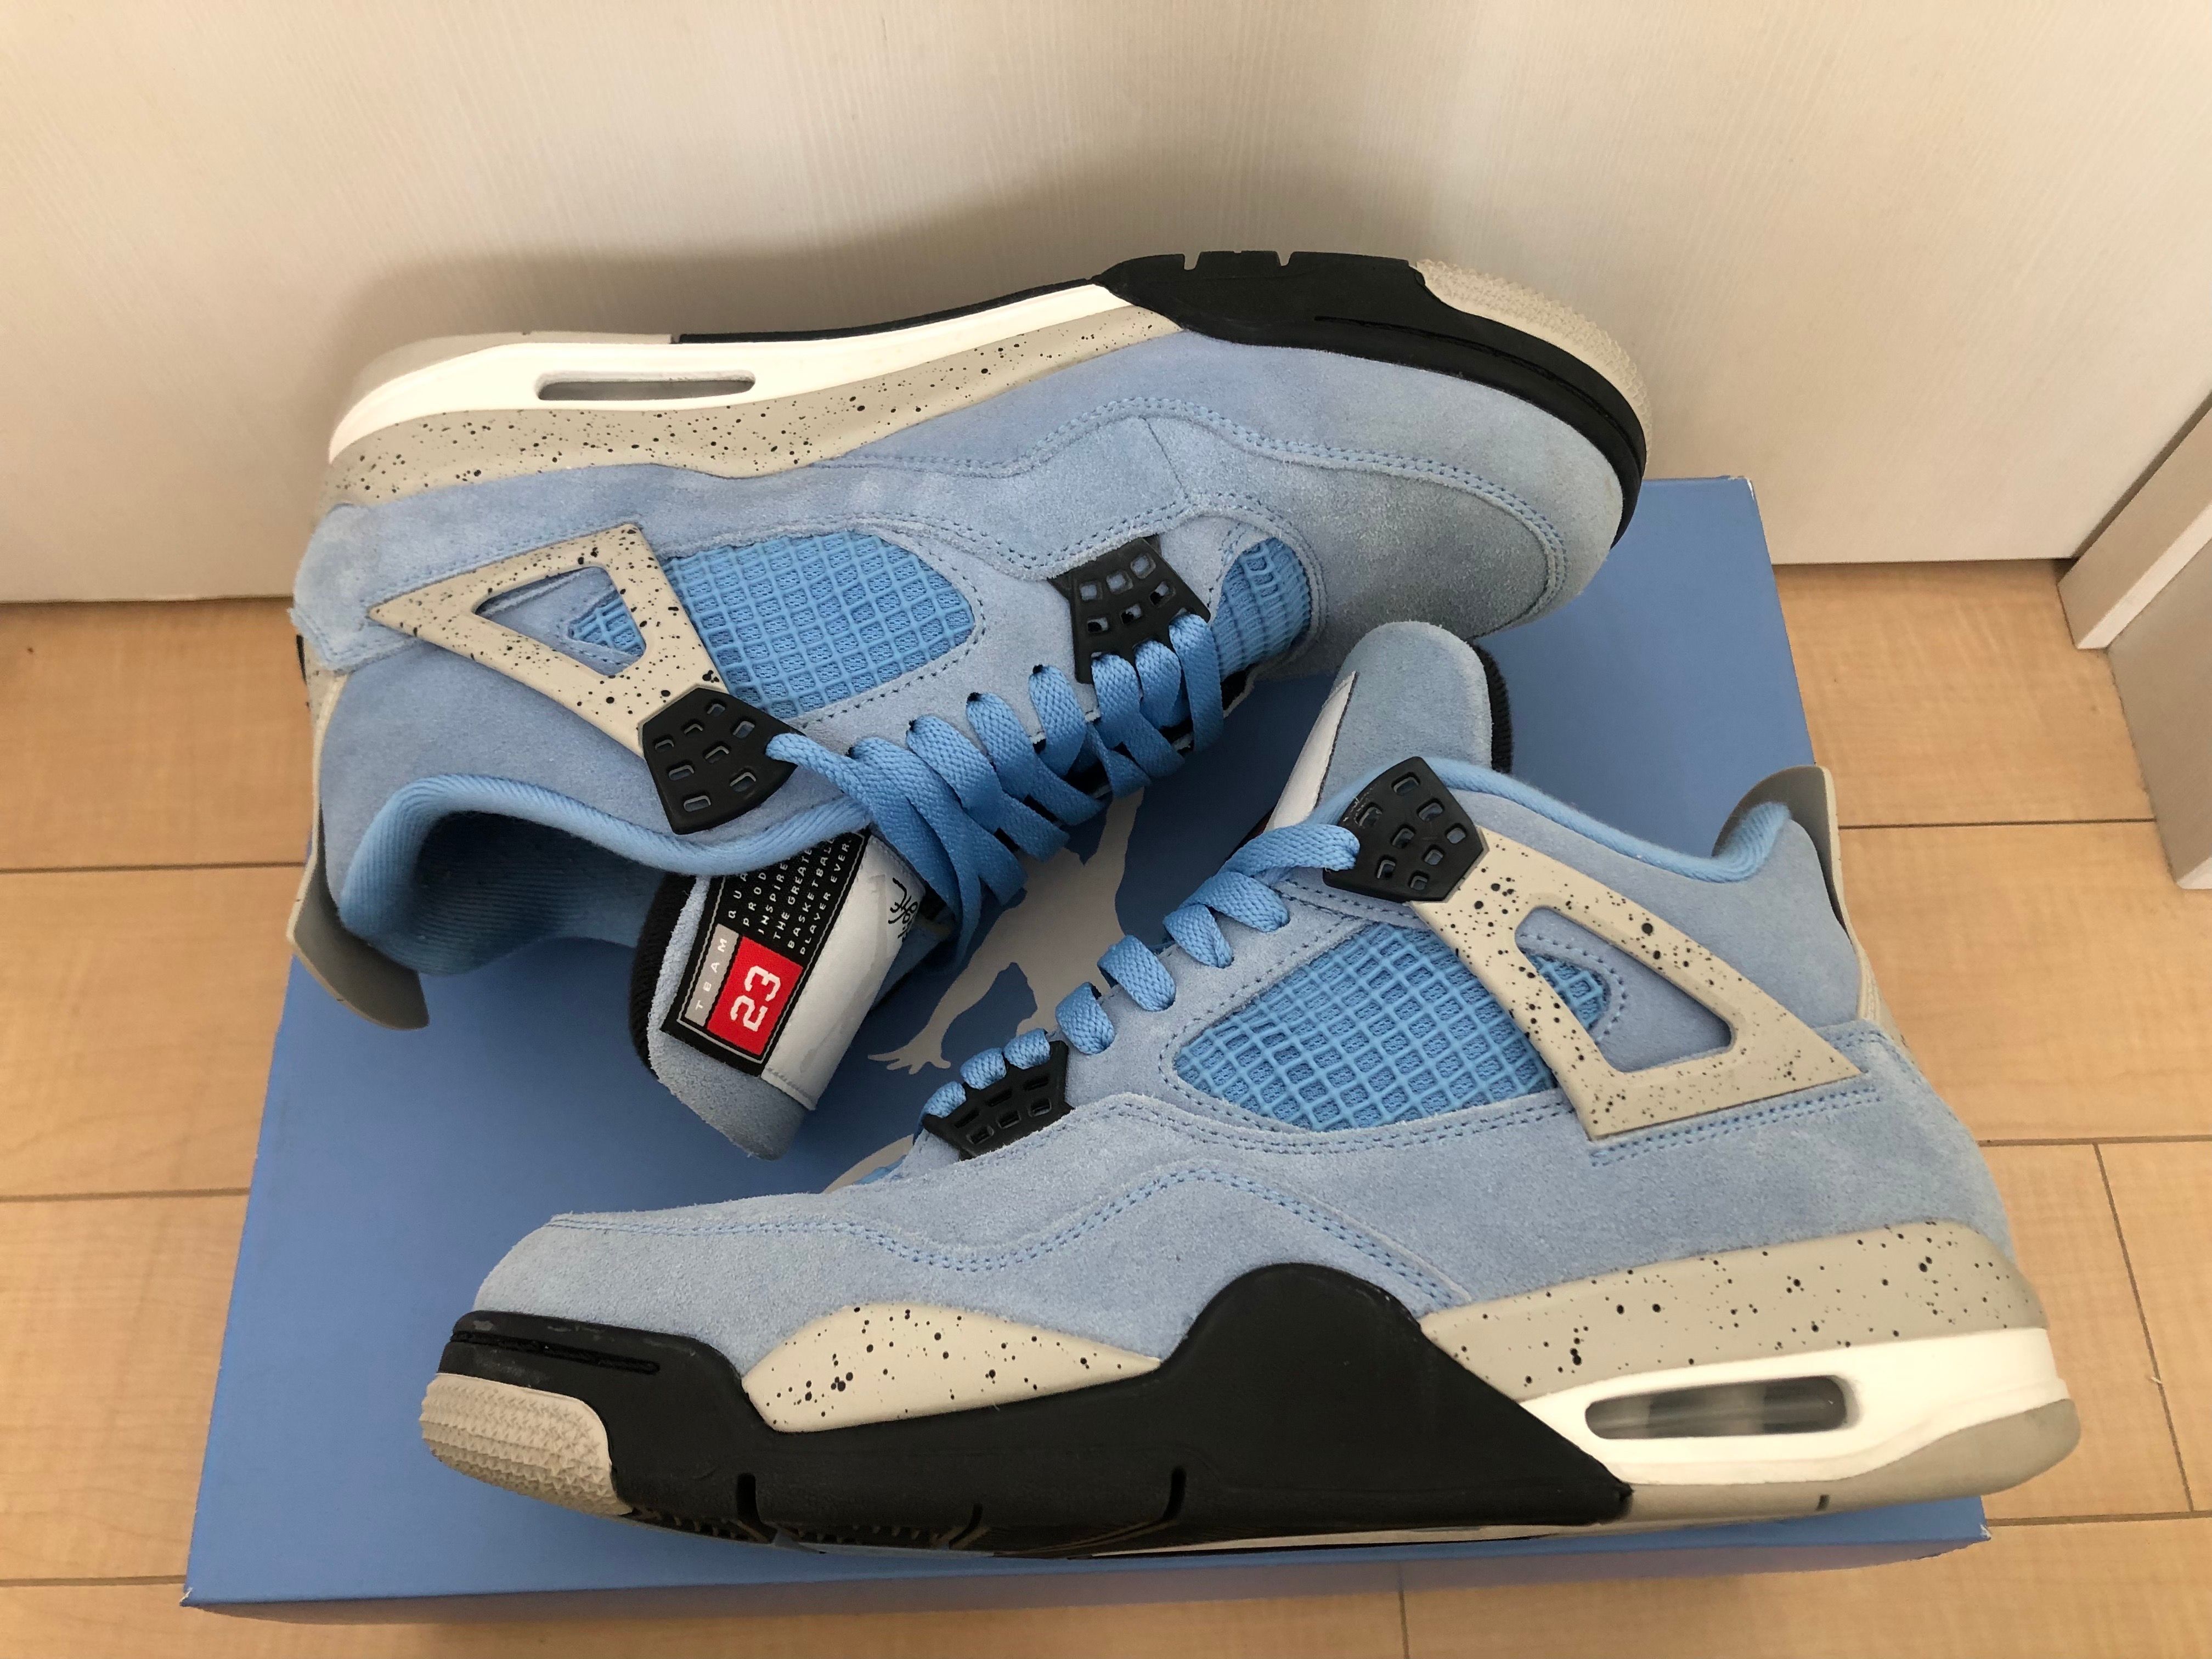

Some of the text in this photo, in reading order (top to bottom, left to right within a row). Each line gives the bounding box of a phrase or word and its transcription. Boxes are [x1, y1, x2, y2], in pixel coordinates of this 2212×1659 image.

[758, 857, 791, 934] INSPIRE
[773, 912, 790, 940] THE
[787, 839, 834, 949] BASKETBALL
[799, 840, 852, 955] PLAYER EVER.
[695, 938, 727, 1011] TEAM
[730, 965, 781, 1032] 23
